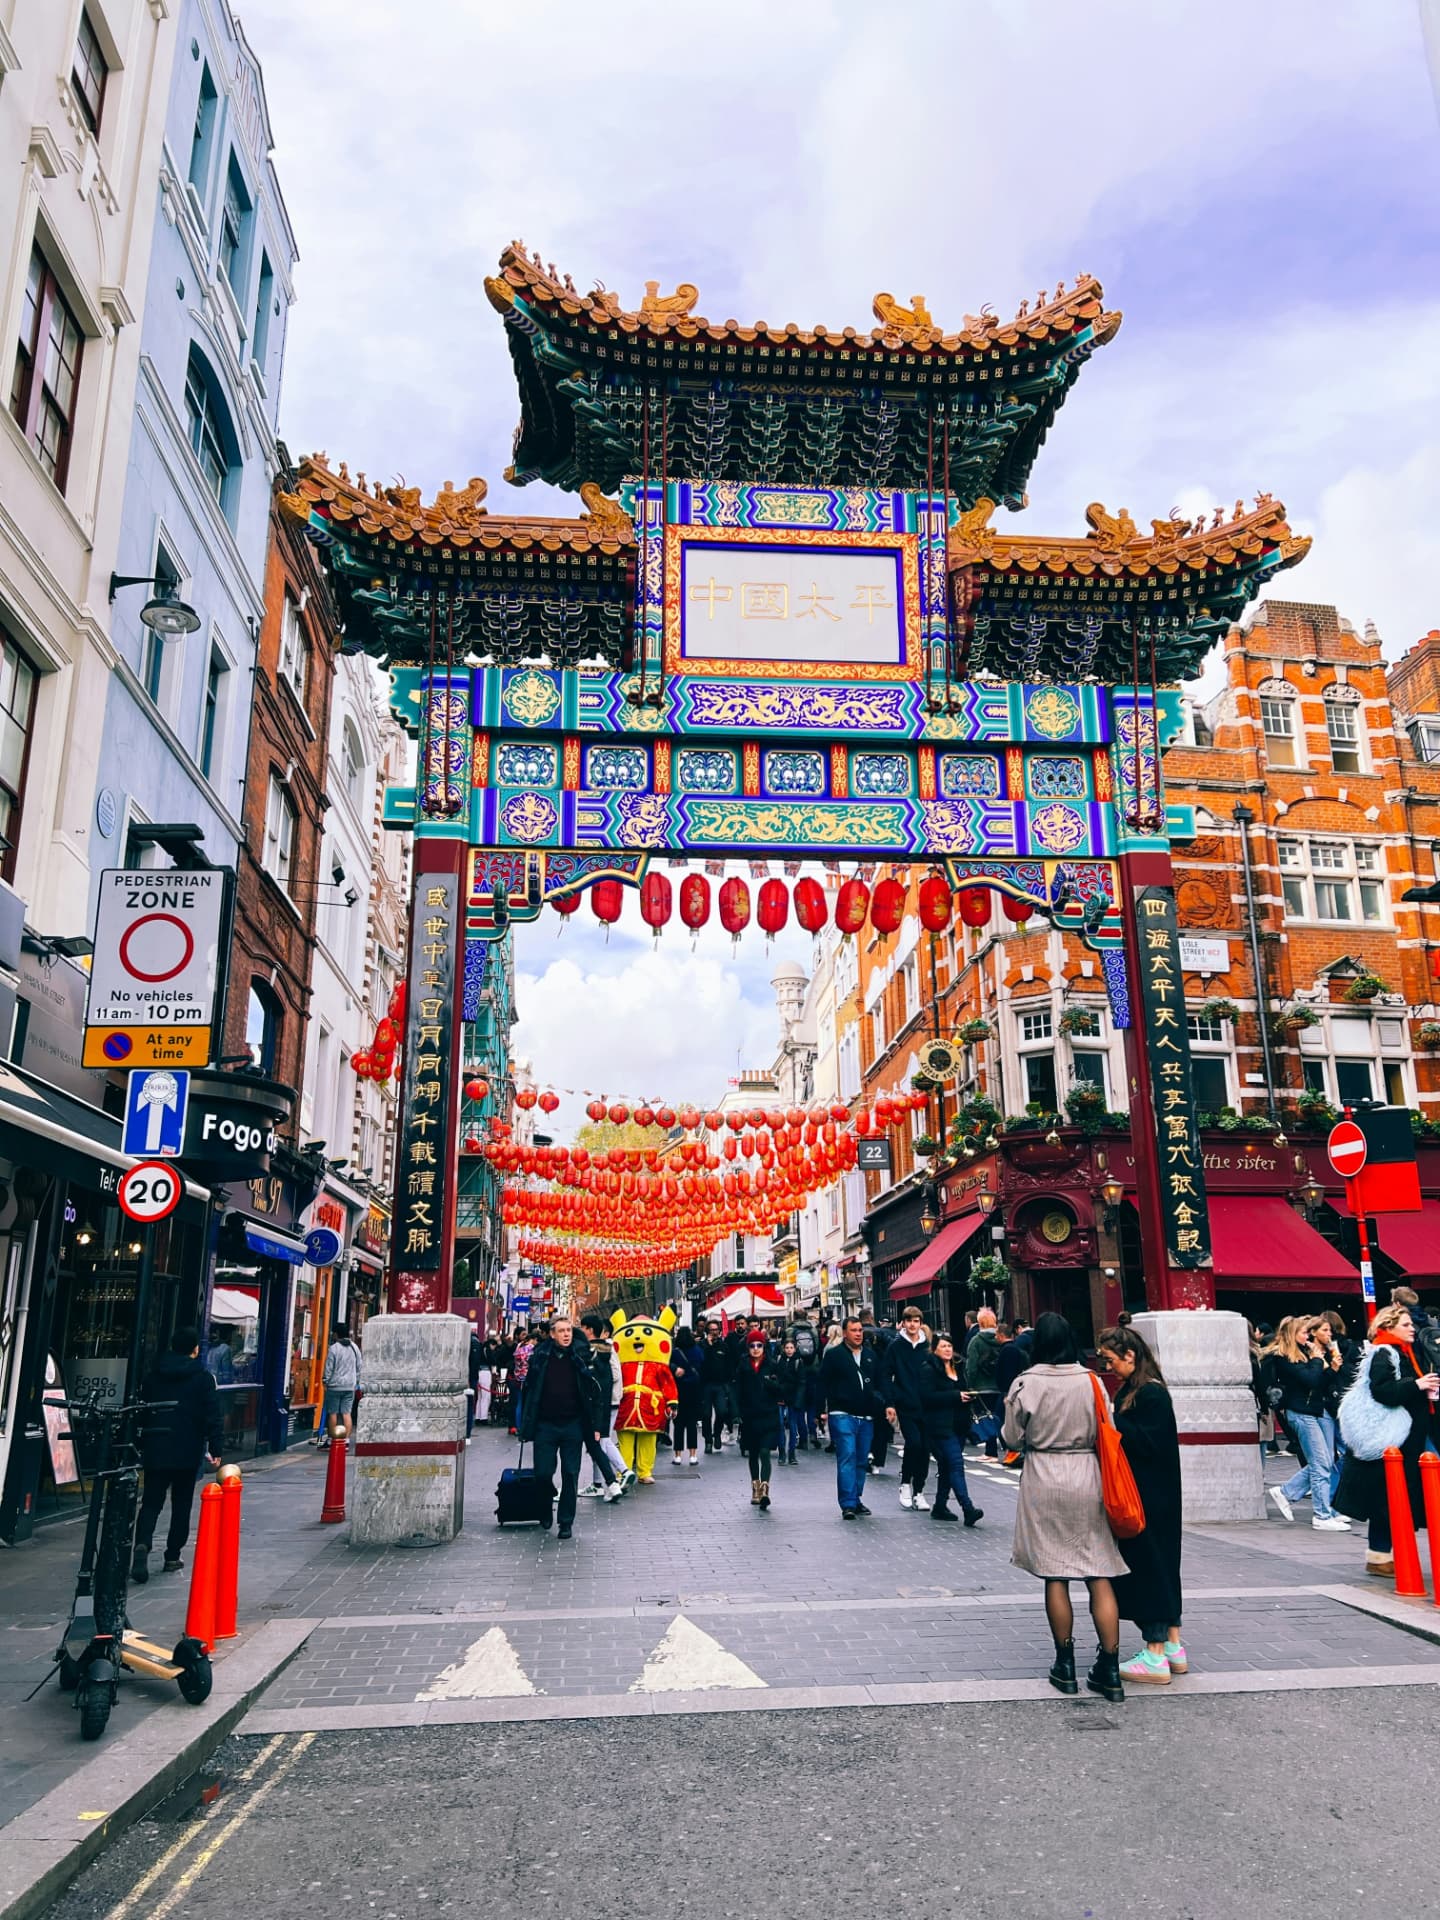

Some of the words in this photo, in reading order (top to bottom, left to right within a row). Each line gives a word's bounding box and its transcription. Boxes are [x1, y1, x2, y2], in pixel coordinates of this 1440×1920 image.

[688, 576, 894, 625] 中國太平
[114, 875, 212, 887] PEDESTRIAN
[126, 892, 195, 909] ZONE
[1182, 948, 1205, 956] STREET
[110, 990, 130, 1002] No
[136, 990, 193, 1002] vehicles
[147, 1004, 169, 1020] 10
[174, 1008, 202, 1022] pm
[146, 1034, 163, 1045] At
[168, 1036, 193, 1047] any
[152, 1048, 184, 1060] time
[202, 1113, 262, 1152] Fogo
[865, 1146, 882, 1158] 22
[1235, 1154, 1277, 1171] sister
[100, 1168, 116, 1193] Tel:
[129, 1179, 172, 1203] 20
[75, 1375, 109, 1388] Fogo
